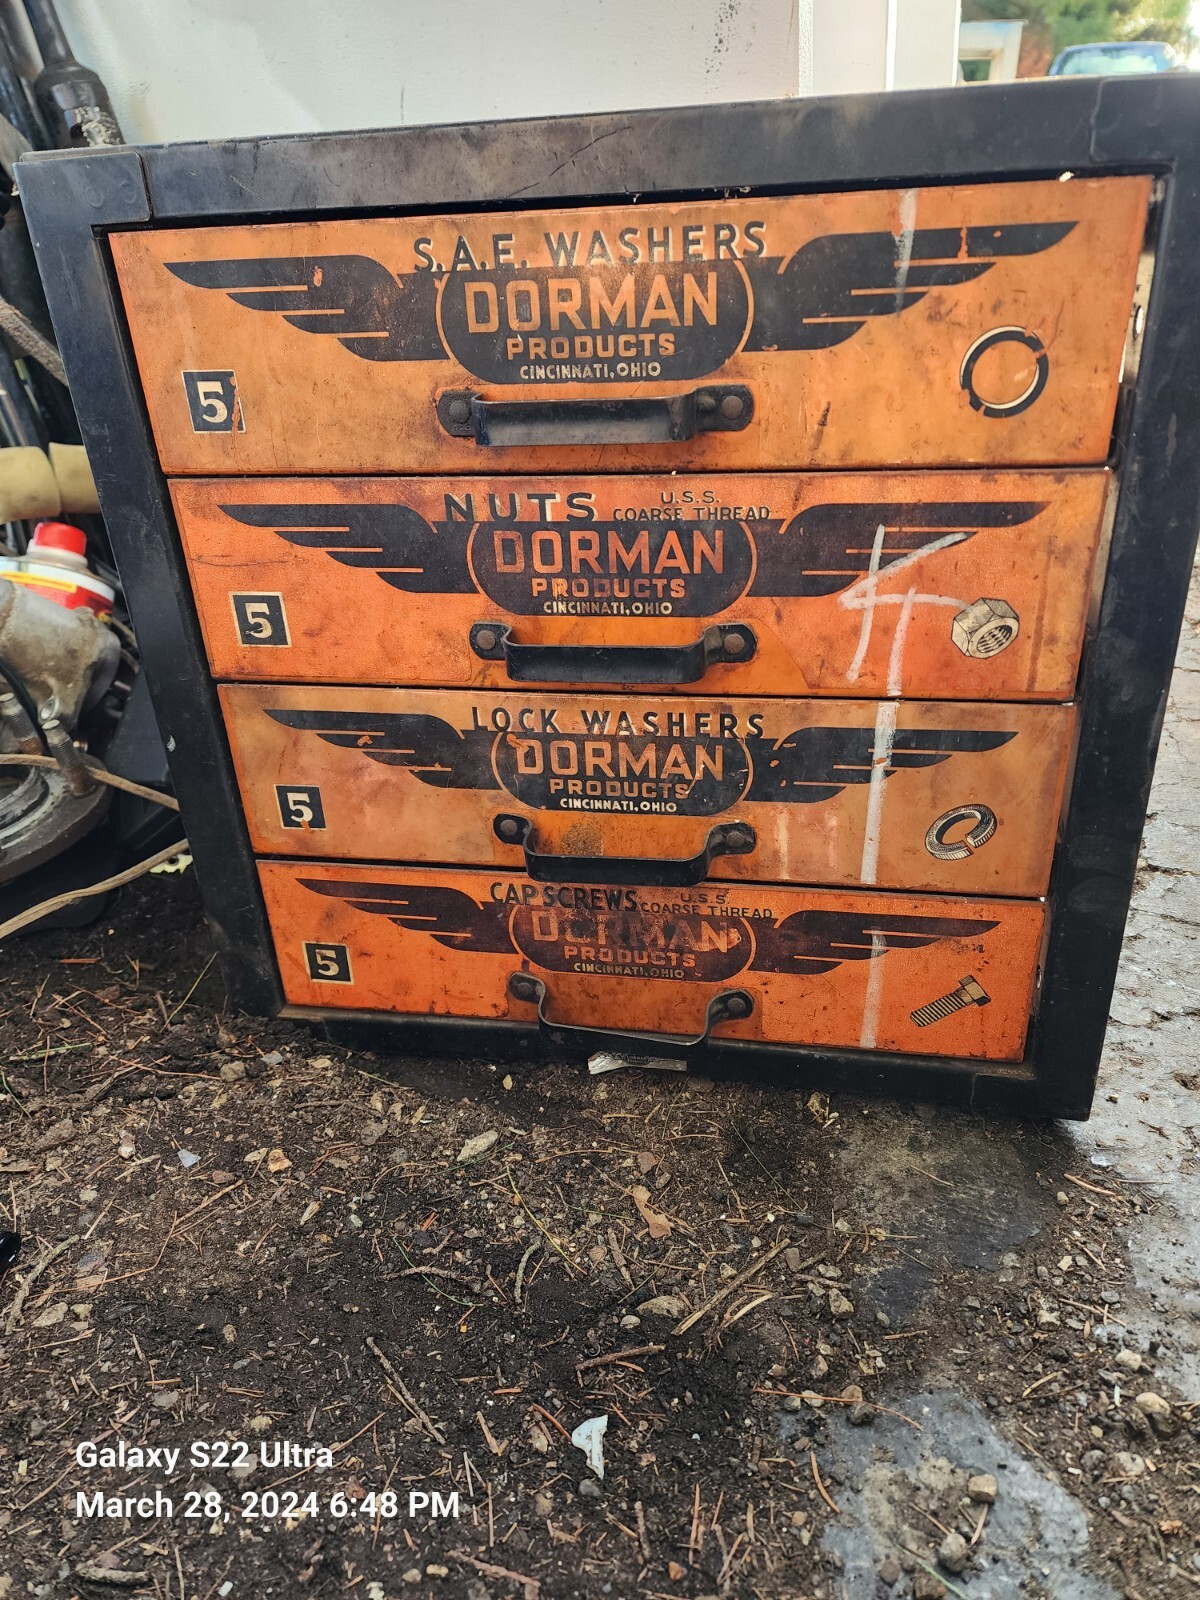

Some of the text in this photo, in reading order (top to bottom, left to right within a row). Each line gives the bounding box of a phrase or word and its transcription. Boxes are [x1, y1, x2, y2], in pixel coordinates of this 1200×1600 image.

[413, 221, 767, 272] S.A.E. WASHERS
[464, 271, 718, 334] DORMAN
[506, 332, 675, 361] PRODUCTS
[196, 381, 228, 423] 5
[444, 492, 598, 522] NUTS
[660, 490, 721, 504] U.S.S.
[613, 506, 770, 521] COARSE THREAD
[493, 530, 724, 575] DORMAN
[532, 577, 686, 599] PRODUCTS
[244, 603, 273, 639] 5
[471, 706, 764, 739] LOCK WASHERS
[517, 738, 724, 781] DORMAN
[549, 778, 690, 799] PRODUCTS
[286, 792, 313, 823] 5
[490, 882, 638, 912] CAP SCREWS
[641, 901, 773, 919] COARSE THREAD
[315, 949, 340, 976] 5
[564, 945, 696, 968] PRODUCTS
